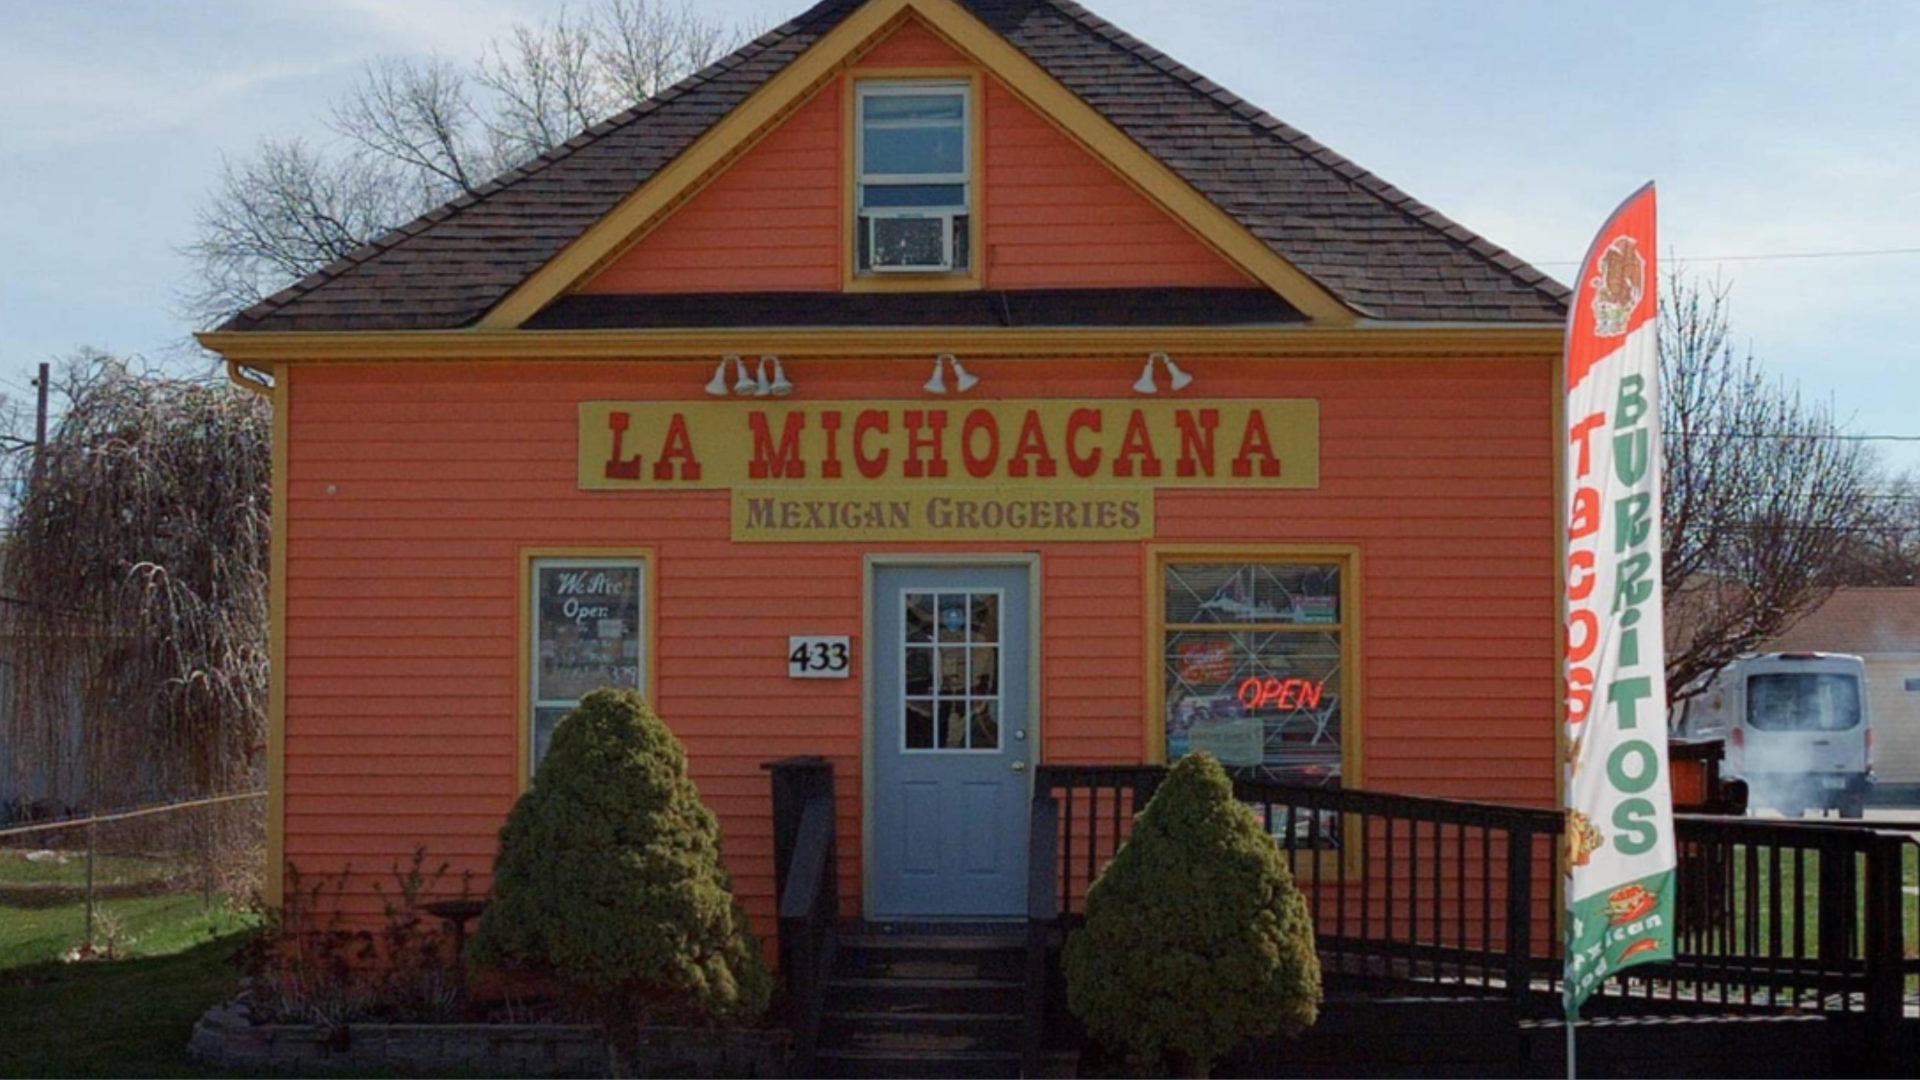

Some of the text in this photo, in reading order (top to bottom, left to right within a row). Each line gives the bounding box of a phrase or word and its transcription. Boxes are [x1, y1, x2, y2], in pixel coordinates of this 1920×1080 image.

[604, 408, 1281, 481] LA MICHOACANA
[557, 570, 622, 595] We Are
[562, 596, 609, 627] Open
[789, 641, 849, 672] 433
[1236, 676, 1326, 711] OPEN
